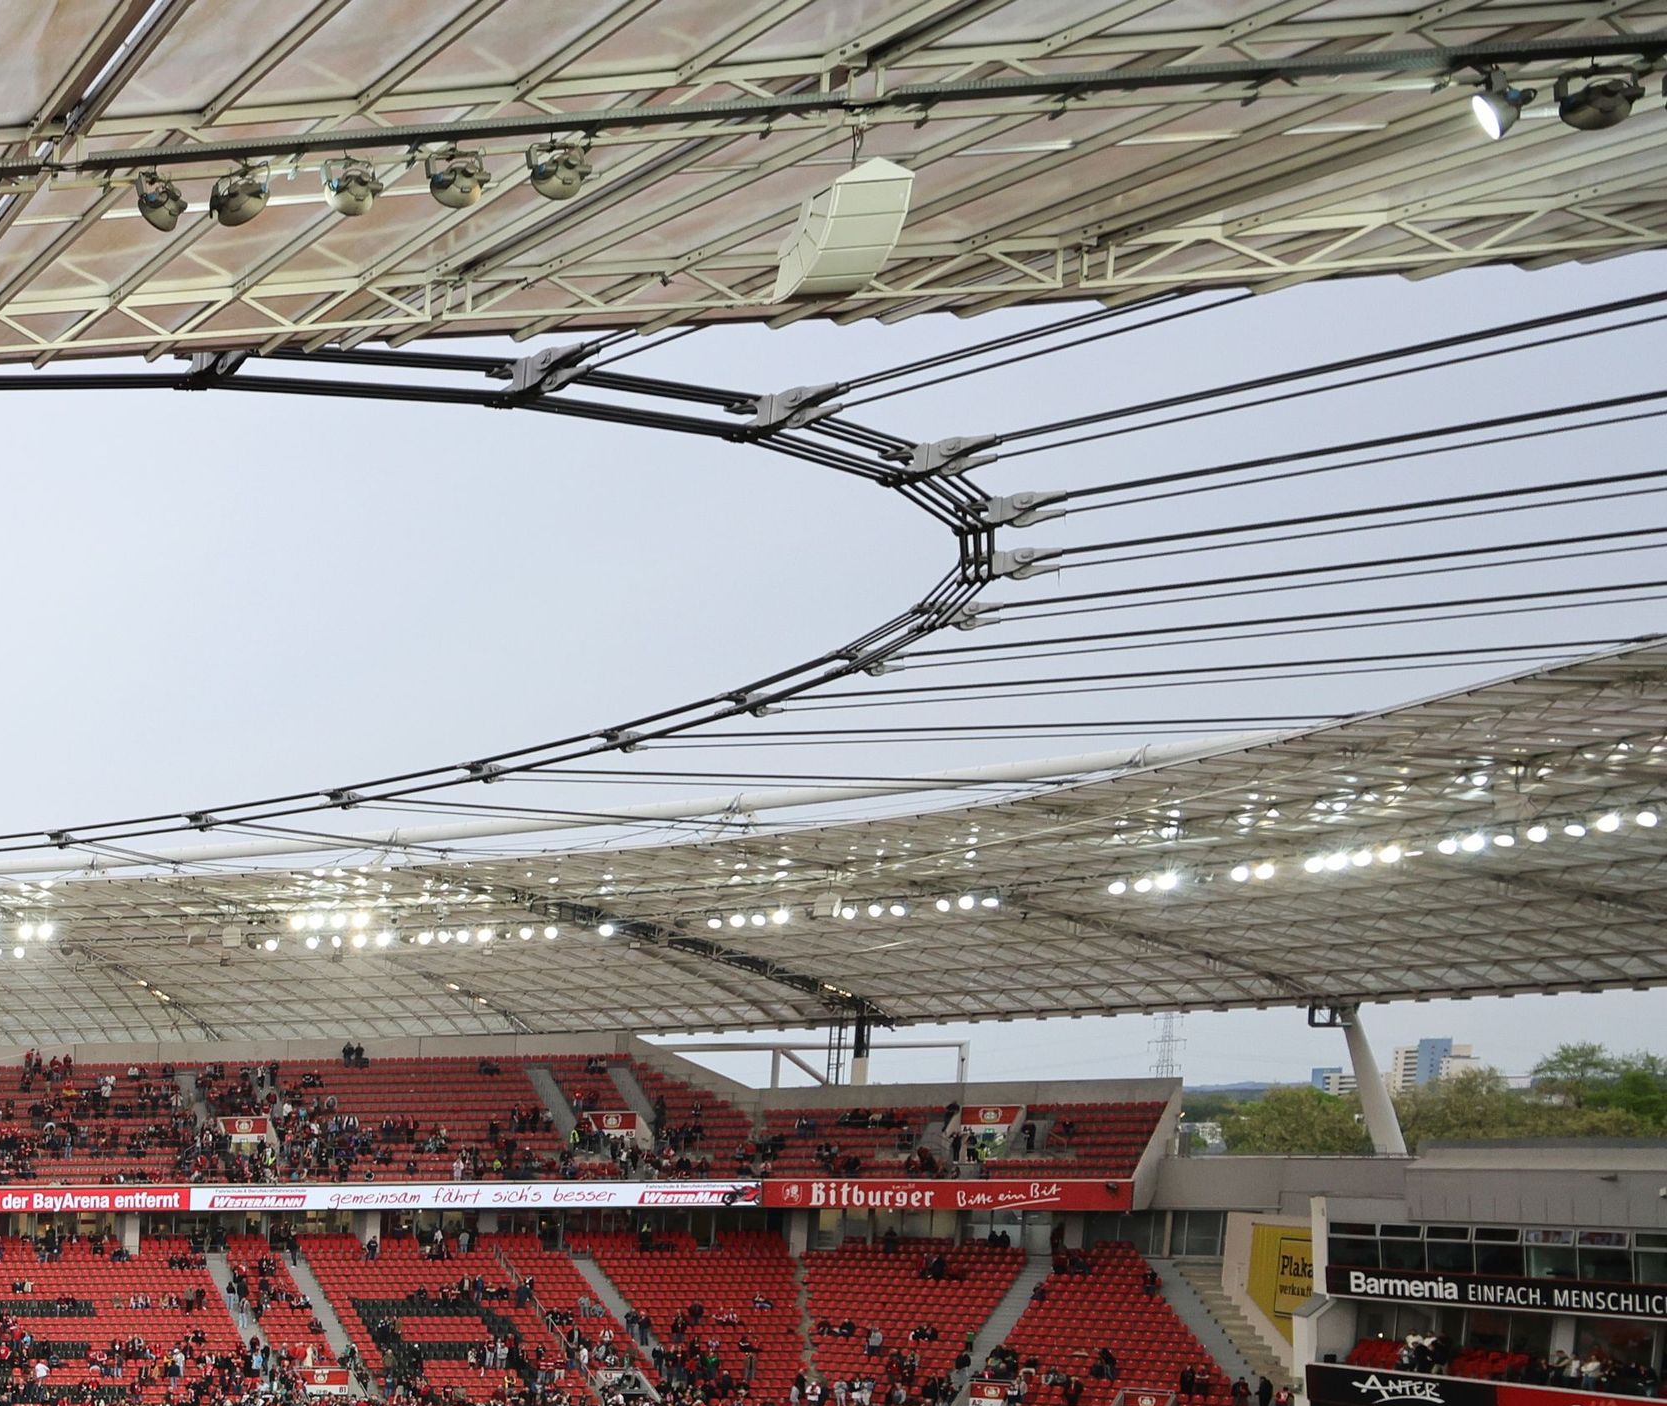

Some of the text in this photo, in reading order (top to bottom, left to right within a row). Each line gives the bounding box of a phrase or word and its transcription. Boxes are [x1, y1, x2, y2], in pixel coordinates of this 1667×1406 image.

[2, 1194, 29, 1209] der
[33, 1193, 109, 1212] BayArena
[114, 1192, 180, 1208] entfernt
[211, 1194, 304, 1207] WESTERMANN
[329, 1186, 616, 1210] gemeinsam fährt sich's besser
[643, 1191, 723, 1205] WESTERMA
[810, 1182, 935, 1207] Bitburger
[957, 1183, 1061, 1208] Bitte ein Bit
[1350, 1271, 1458, 1301] Barmenia
[1468, 1283, 1547, 1307] EINFACH.
[1352, 1375, 1440, 1398] ANTER
